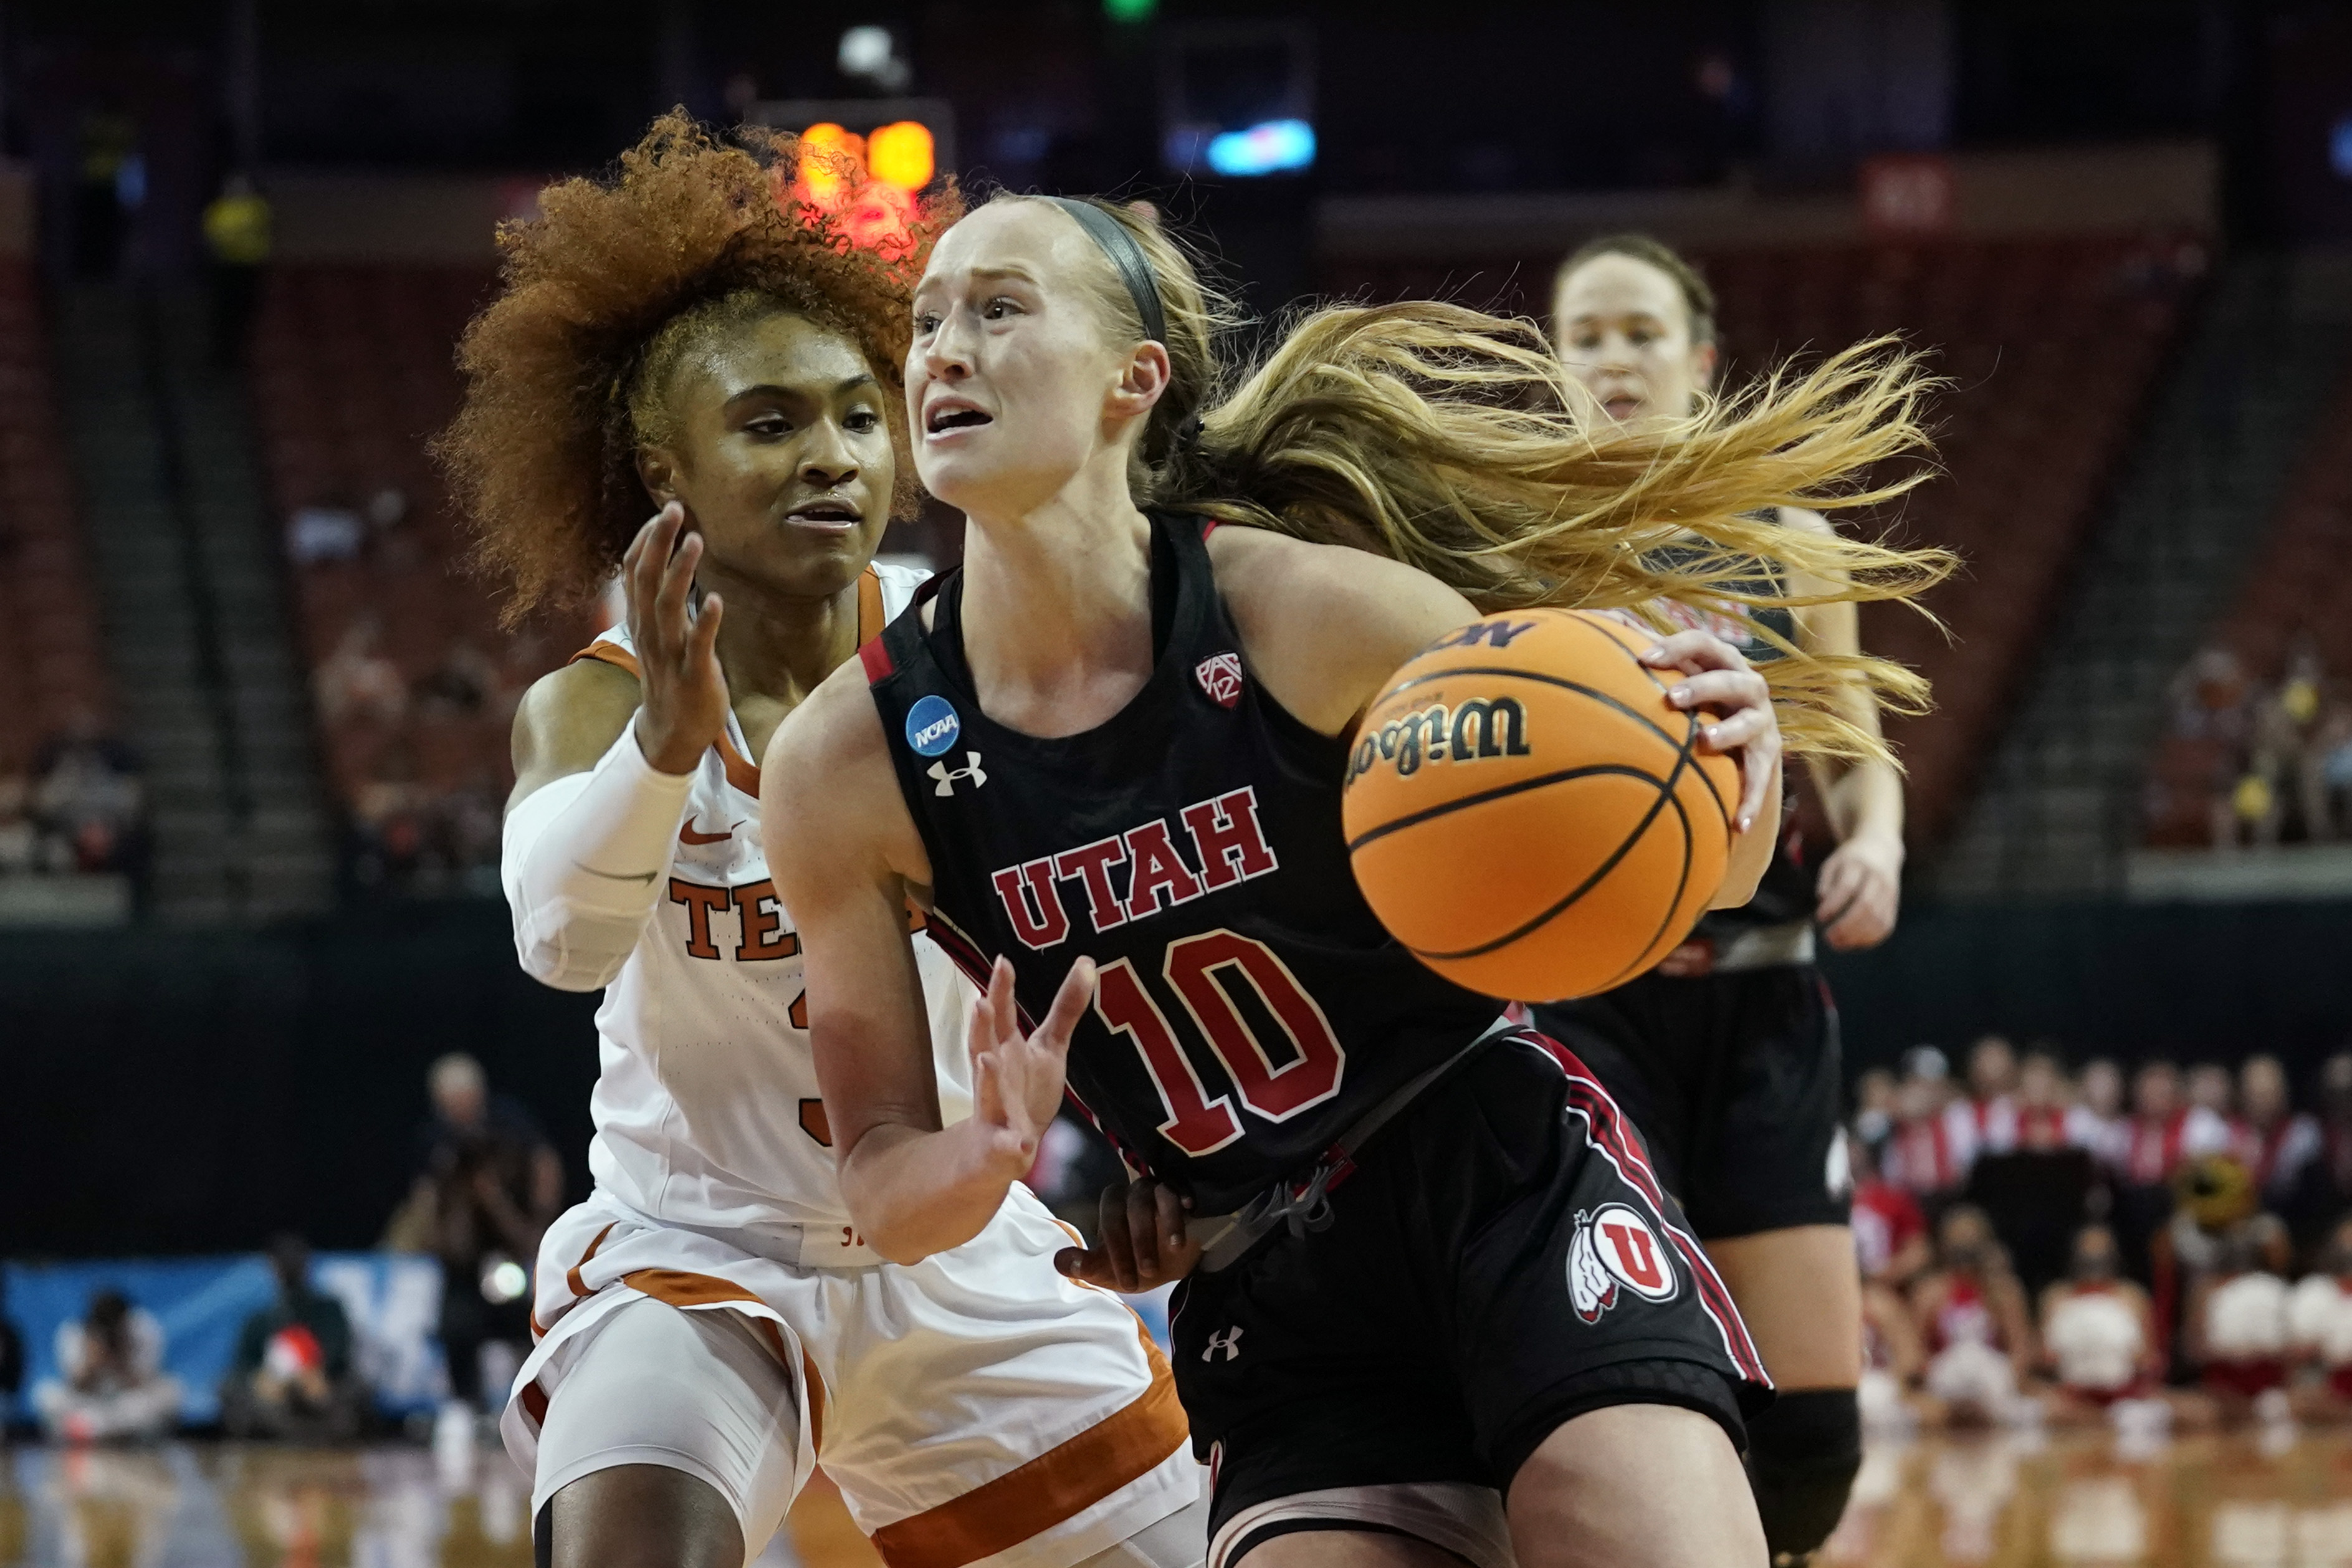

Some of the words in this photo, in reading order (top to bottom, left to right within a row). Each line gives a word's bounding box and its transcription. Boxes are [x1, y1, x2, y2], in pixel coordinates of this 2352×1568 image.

[1196, 653, 1242, 694] PAC
[1212, 676, 1240, 702] 12
[915, 714, 958, 748] NCAA
[992, 785, 1279, 950] UTAH
[669, 877, 804, 962] TE
[1093, 927, 1346, 1158] 10
[1601, 1223, 1663, 1289] U
